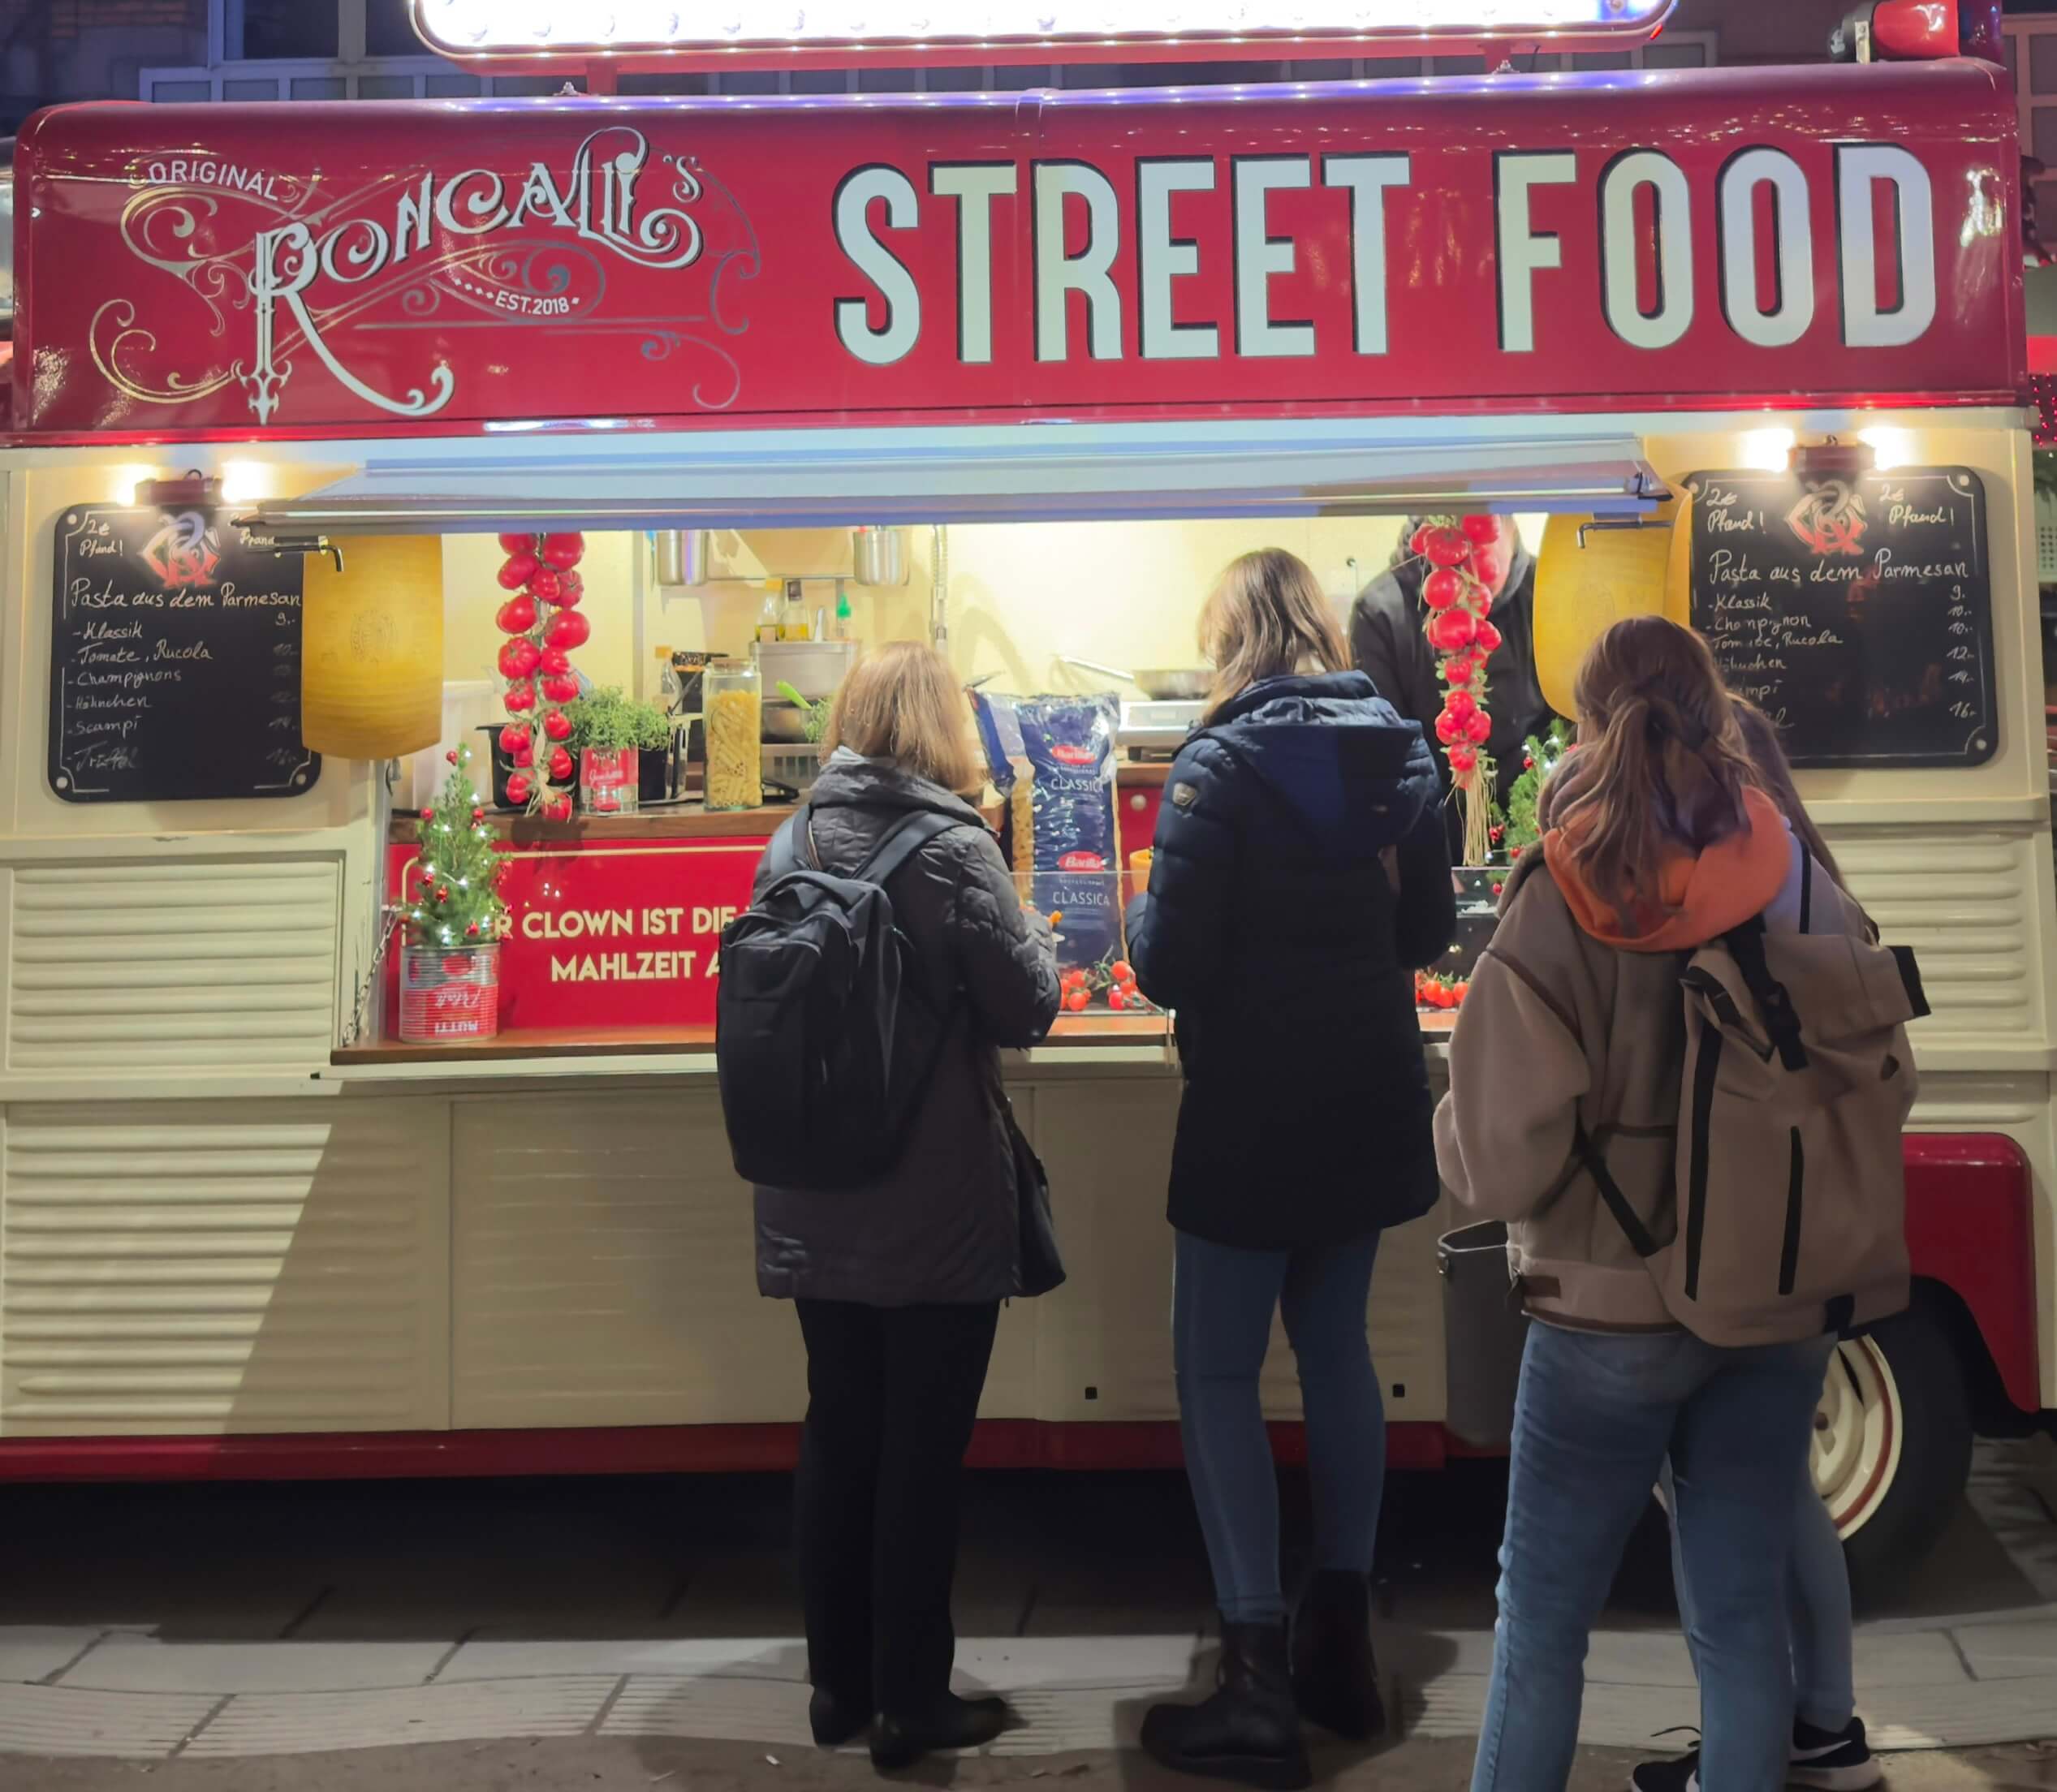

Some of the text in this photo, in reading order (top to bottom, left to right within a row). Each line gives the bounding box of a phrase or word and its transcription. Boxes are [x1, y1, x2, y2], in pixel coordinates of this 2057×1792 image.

[148, 161, 280, 203] ORIGINAL
[832, 142, 1937, 365] STREET FOOD
[1709, 548, 1969, 585] Pasta aus dem Parmesan
[71, 578, 302, 608] Pasta aus dem Parmesan
[153, 639, 213, 661] Rucola
[1052, 891, 1110, 907] CLASSICA
[522, 909, 632, 939] CLOWN
[642, 907, 684, 936] IST
[550, 951, 696, 982] MAHLZEIT
